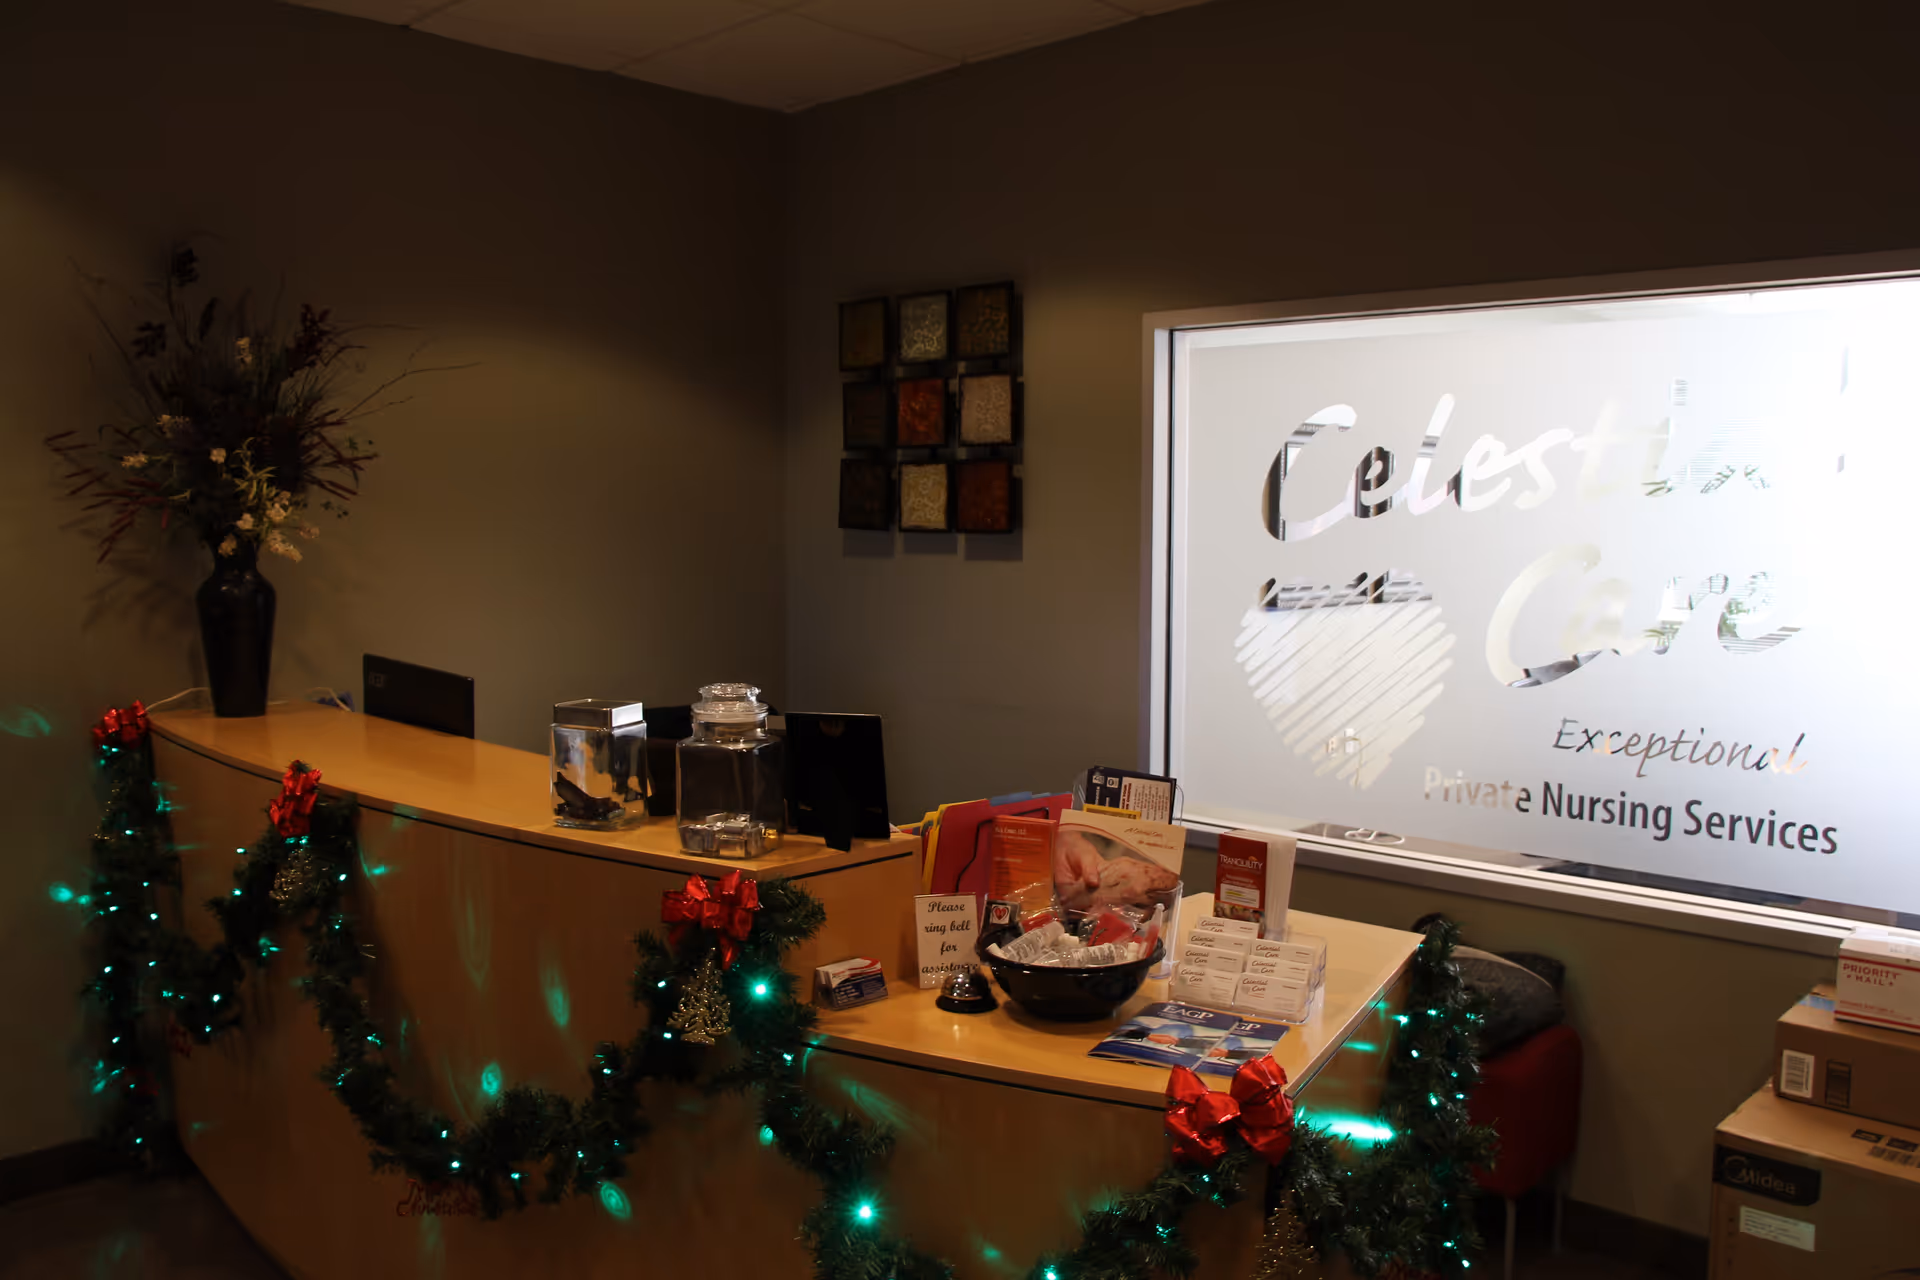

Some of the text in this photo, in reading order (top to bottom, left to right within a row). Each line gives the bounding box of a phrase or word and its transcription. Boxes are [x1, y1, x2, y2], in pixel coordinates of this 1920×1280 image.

[1261, 345, 1848, 542] Celestia
[1486, 543, 1803, 688] Care
[1552, 717, 1810, 778] Exceptional
[1423, 765, 1839, 855] Private Nursing Services
[927, 901, 965, 913] Please
[924, 919, 971, 935] ring bell
[940, 941, 958, 955] for
[1843, 963, 1900, 980] PRIORITY
[1856, 974, 1885, 986] MAIL
